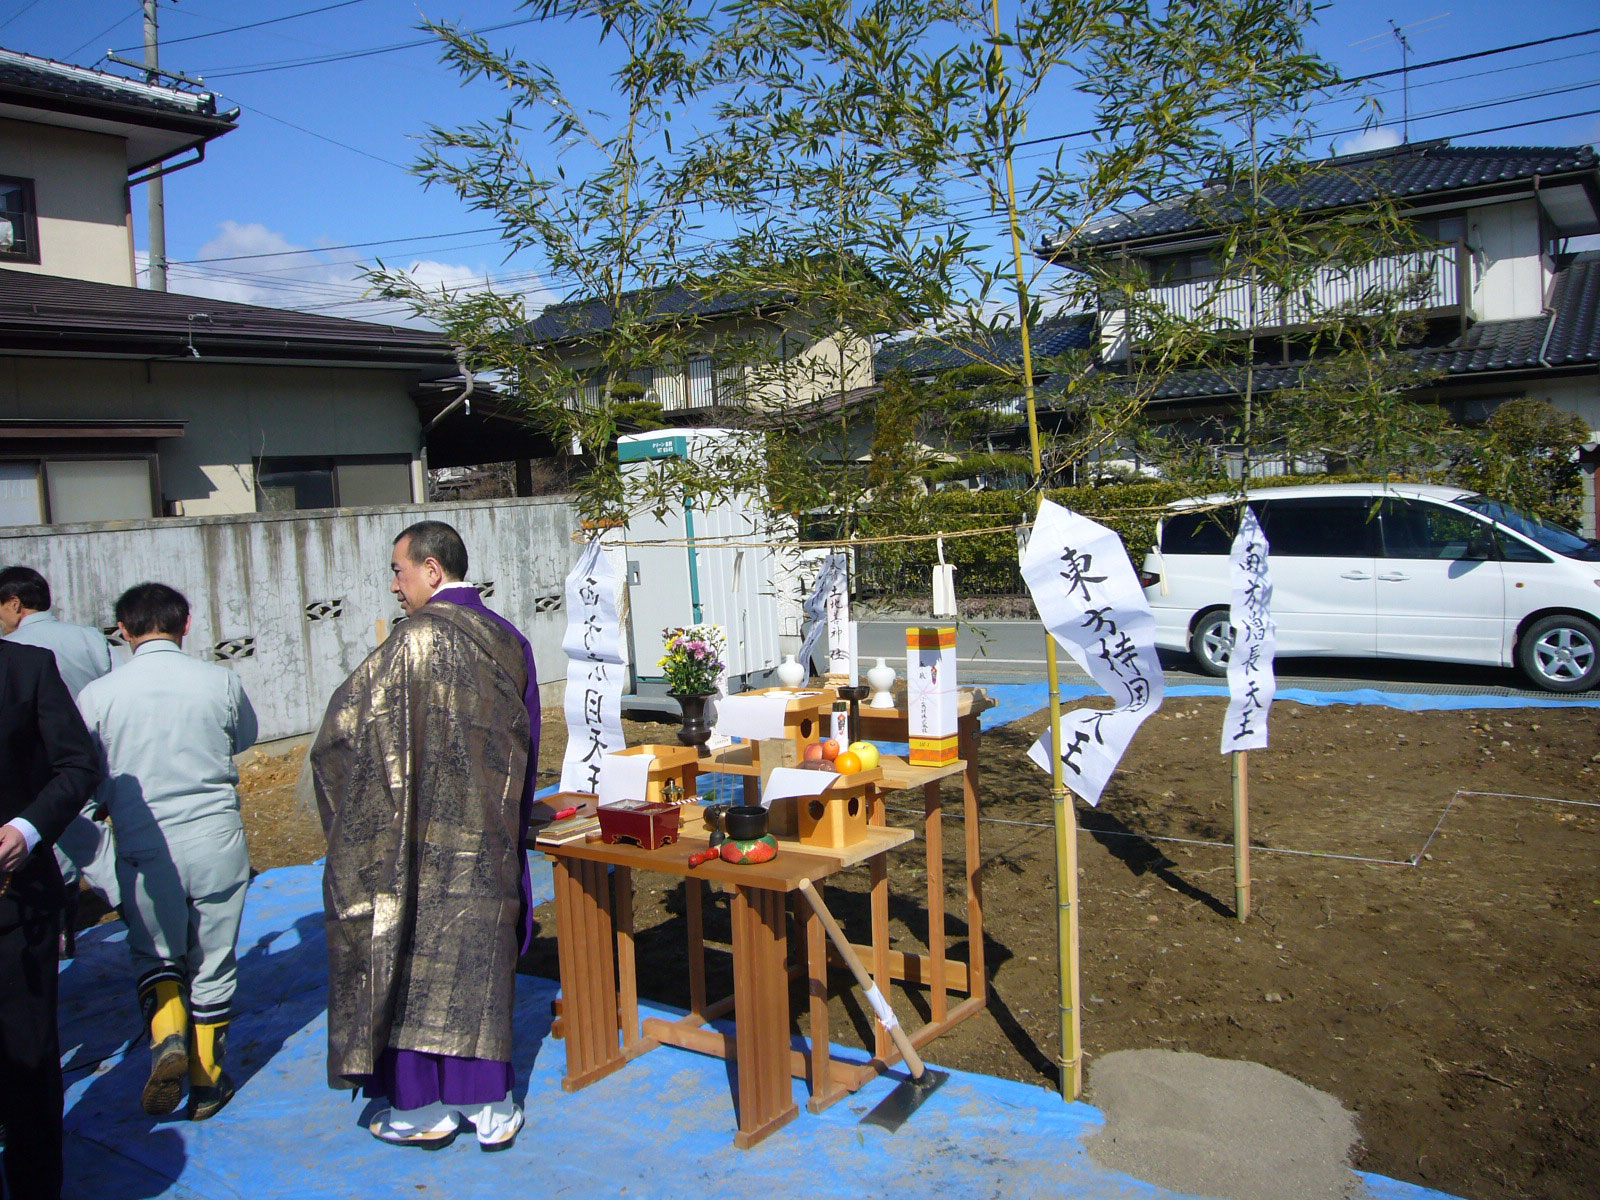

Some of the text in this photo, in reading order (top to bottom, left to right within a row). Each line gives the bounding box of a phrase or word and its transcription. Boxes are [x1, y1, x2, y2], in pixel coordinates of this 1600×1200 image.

[1232, 541, 1267, 741] 南方増長天王
